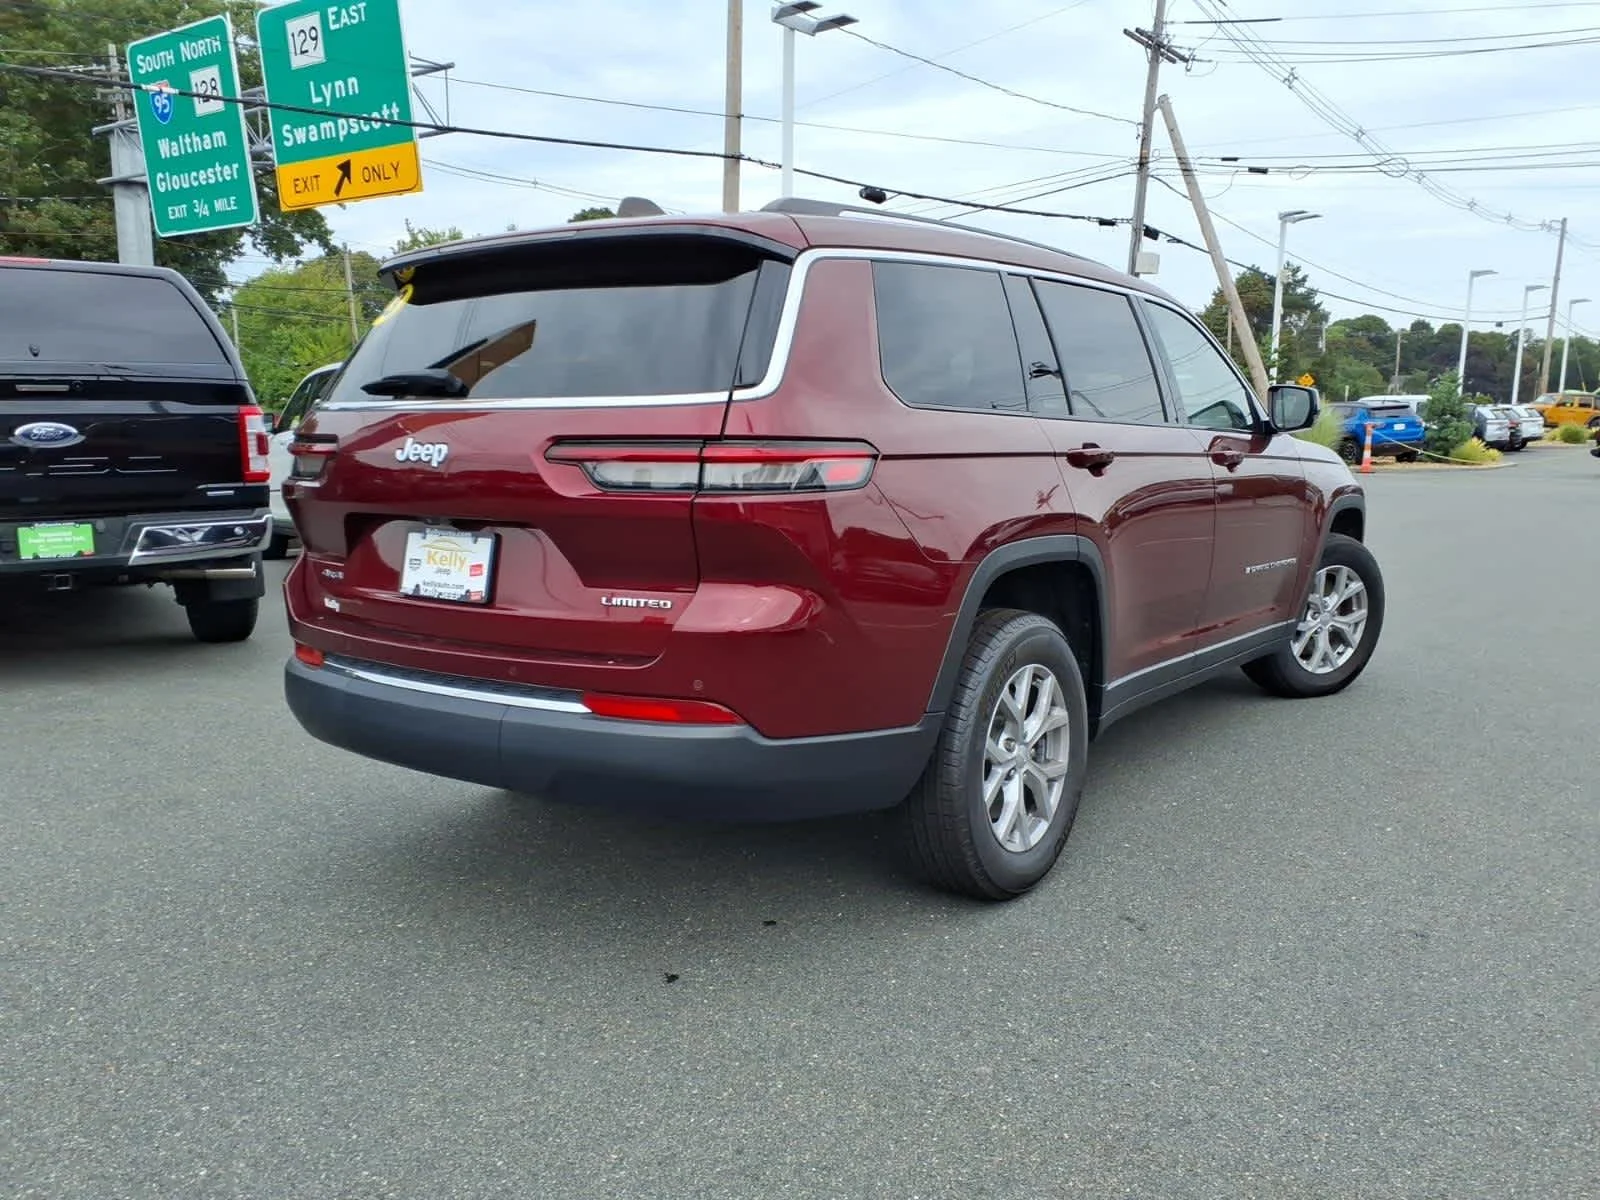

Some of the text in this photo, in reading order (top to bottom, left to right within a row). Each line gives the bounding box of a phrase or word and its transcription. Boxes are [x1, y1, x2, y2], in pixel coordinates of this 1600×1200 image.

[328, 2, 367, 31] EAST
[136, 35, 222, 75] SOUTH NORTH
[291, 26, 319, 56] 129
[153, 93, 170, 114] 95
[194, 77, 219, 105] 128
[309, 76, 359, 107] Lynn
[281, 101, 400, 147] Swampscott
[157, 130, 227, 159] Waltham
[156, 162, 239, 192] Gloucester
[292, 161, 400, 194] EXIT ONLY
[167, 204, 188, 219] EXIT
[214, 196, 238, 212] MILE
[395, 437, 449, 468] Jeep
[426, 550, 467, 573] Kelly
[600, 596, 673, 609] LIMITED
